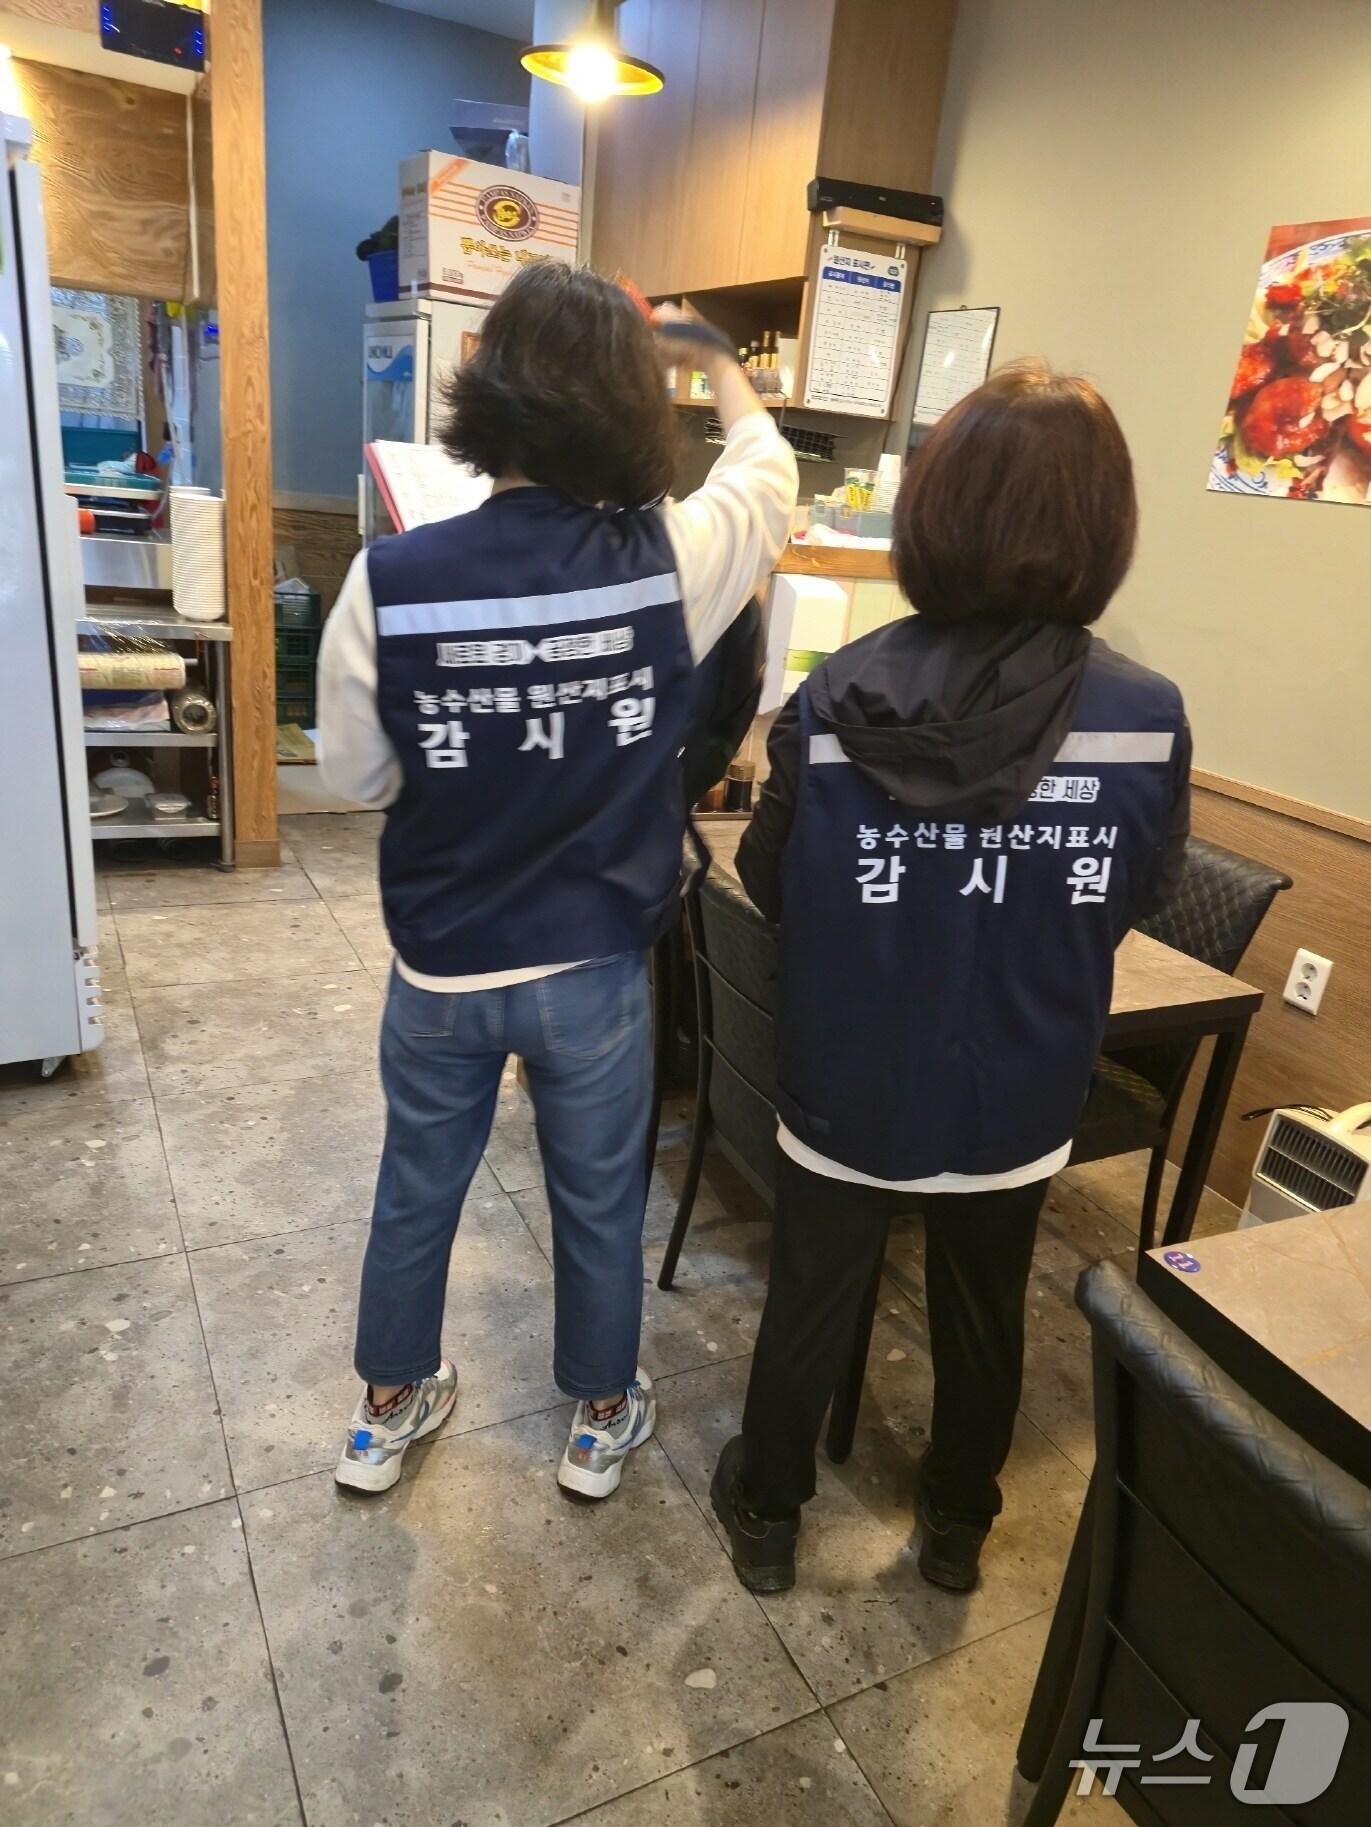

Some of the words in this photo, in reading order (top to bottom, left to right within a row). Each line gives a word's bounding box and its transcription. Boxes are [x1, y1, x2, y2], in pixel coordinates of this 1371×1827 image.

[413, 688, 521, 714] 농수산물
[526, 665, 655, 709] 원산지표시
[1062, 778, 1097, 801] 세상
[856, 823, 967, 850] 농수산물
[979, 824, 1118, 850] 원산지표시
